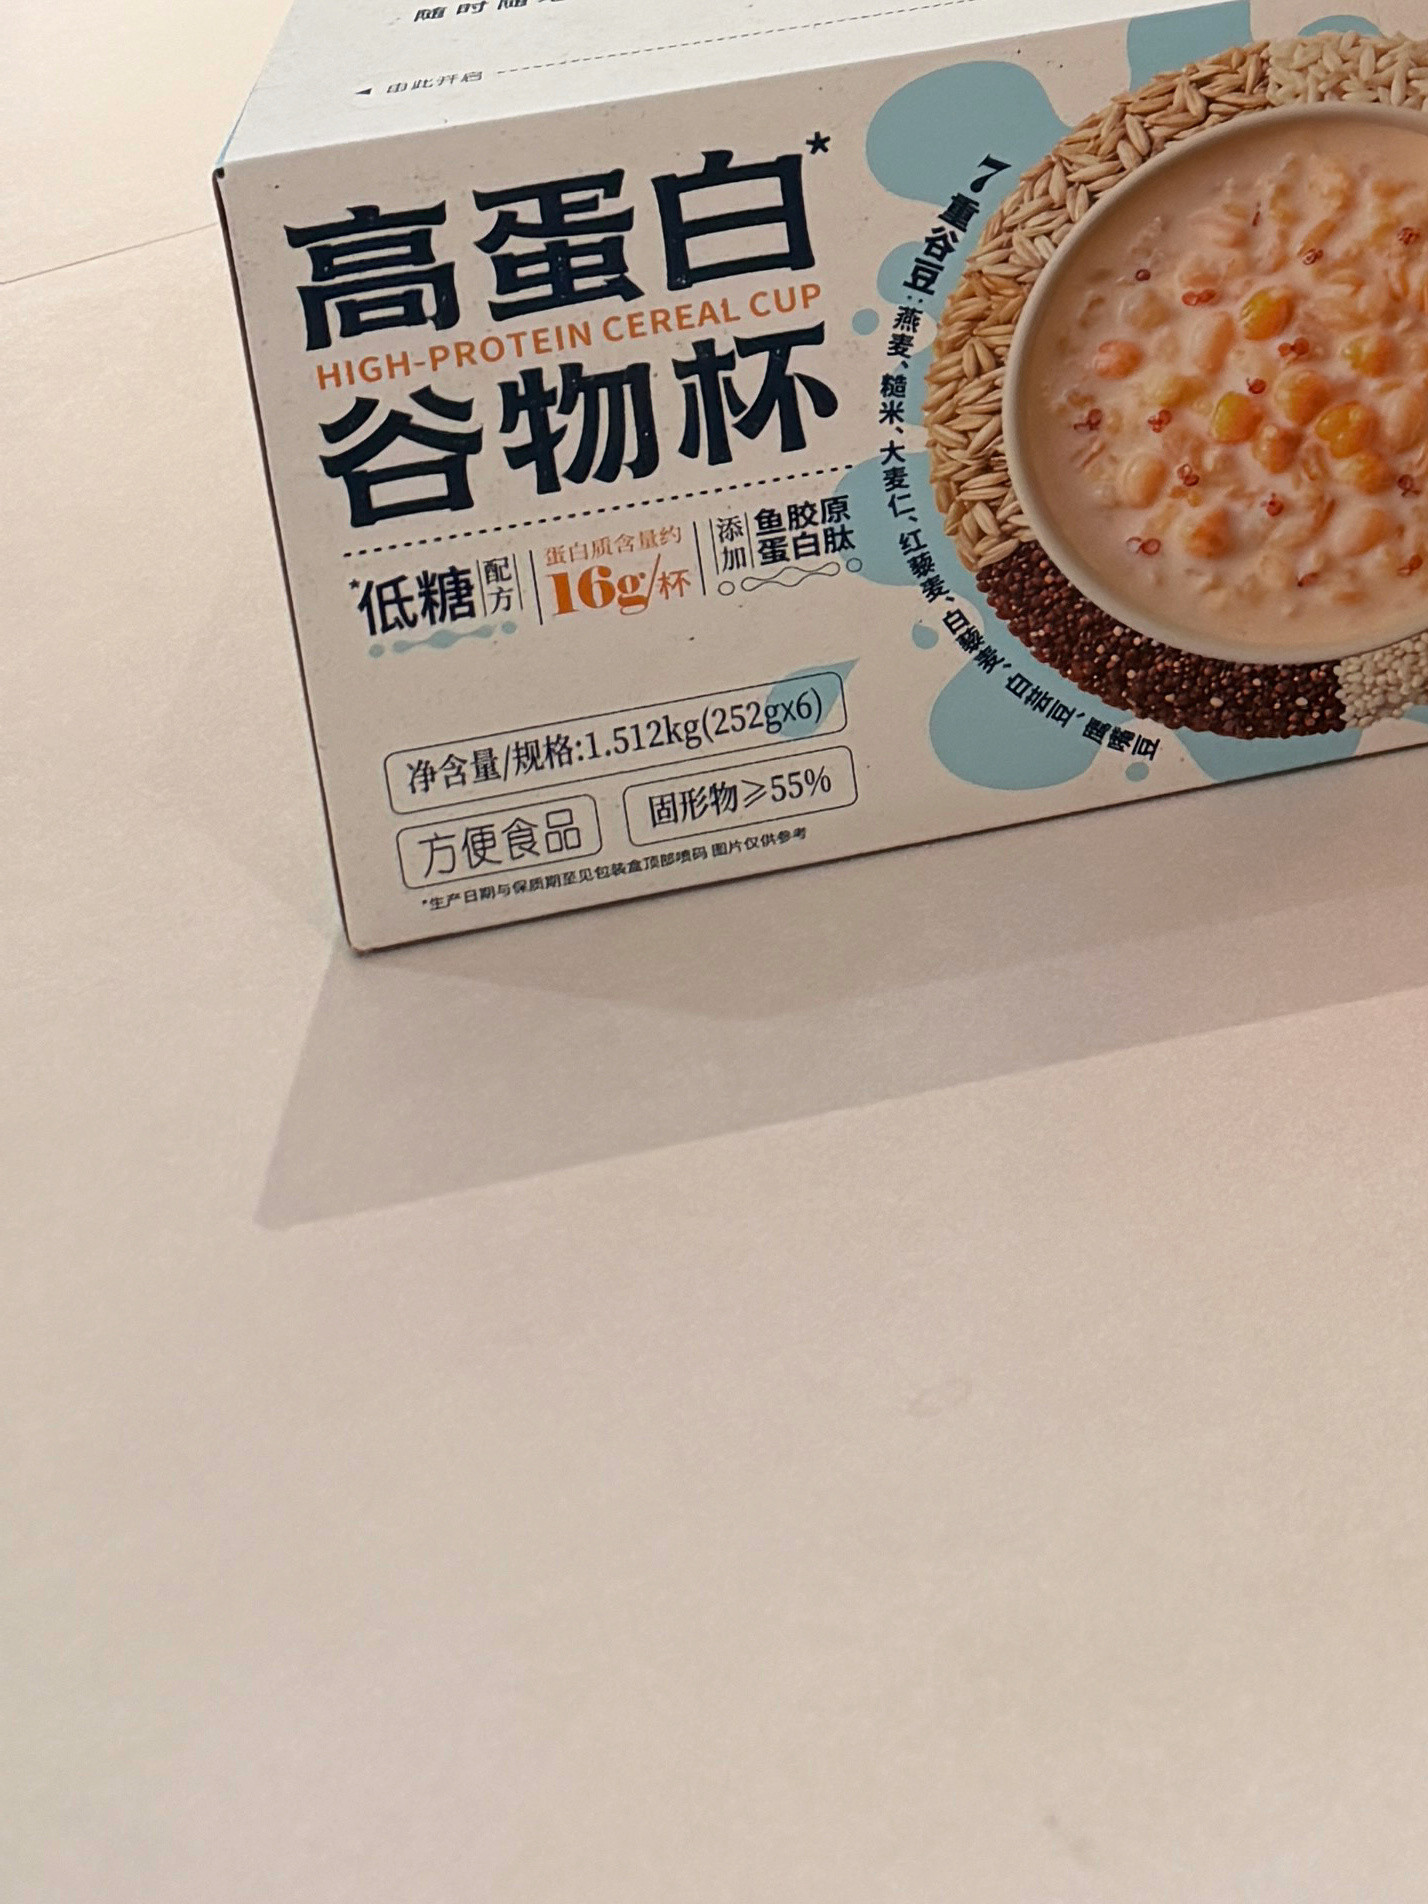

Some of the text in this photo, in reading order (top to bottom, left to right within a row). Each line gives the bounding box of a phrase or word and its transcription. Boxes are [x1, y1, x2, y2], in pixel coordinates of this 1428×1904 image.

[387, 69, 484, 94] 由此开启
[316, 282, 822, 391] HIGH-PROTEIN CEREAL CUP
[318, 321, 838, 528] 谷物杯
[754, 495, 850, 537] 鱼胶原
[545, 525, 683, 566] 蛋白质含量约
[757, 527, 856, 567] 蛋白肽
[551, 554, 692, 617] 16g/杯
[418, 808, 582, 878] 方便食品
